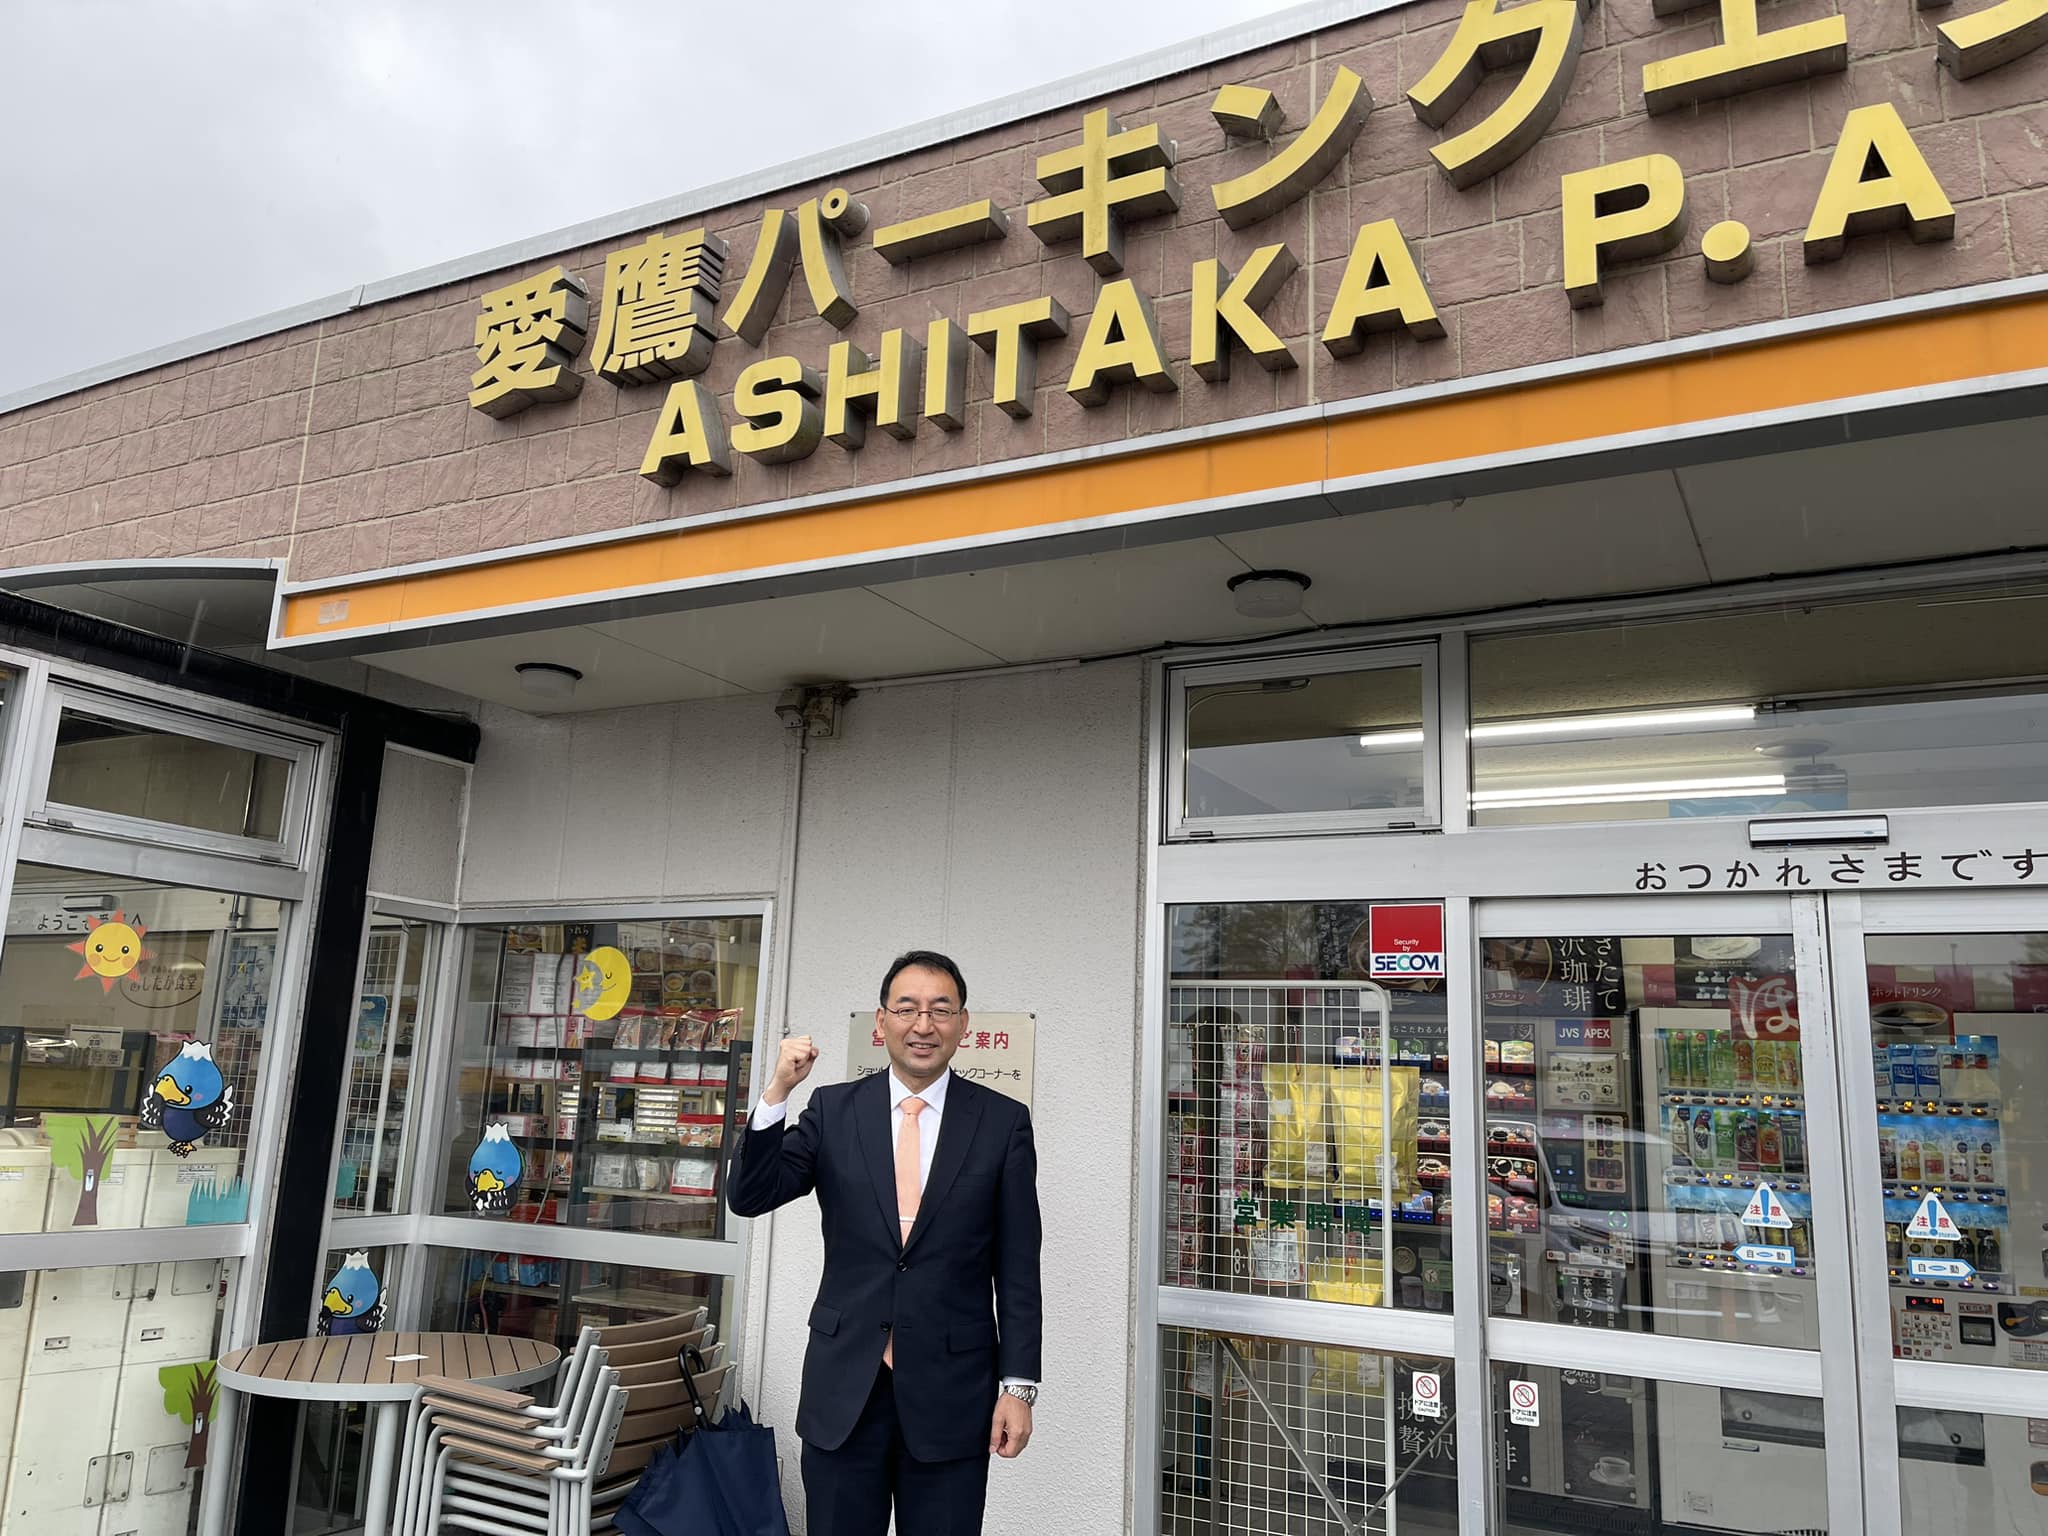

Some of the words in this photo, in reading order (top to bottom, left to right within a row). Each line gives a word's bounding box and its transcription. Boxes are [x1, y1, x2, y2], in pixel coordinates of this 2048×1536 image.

[467, 0, 2048, 412] 愛鷹パーキングエ
[640, 218, 1443, 483] ASHITAKA
[1635, 847, 2048, 891] おつかれさまです
[1393, 938, 1419, 947] Security
[1375, 954, 1439, 971] SECOM
[1559, 1027, 1580, 1039] JVS
[1583, 1028, 1611, 1039] APEX
[1233, 1197, 1371, 1236] 営業時間
